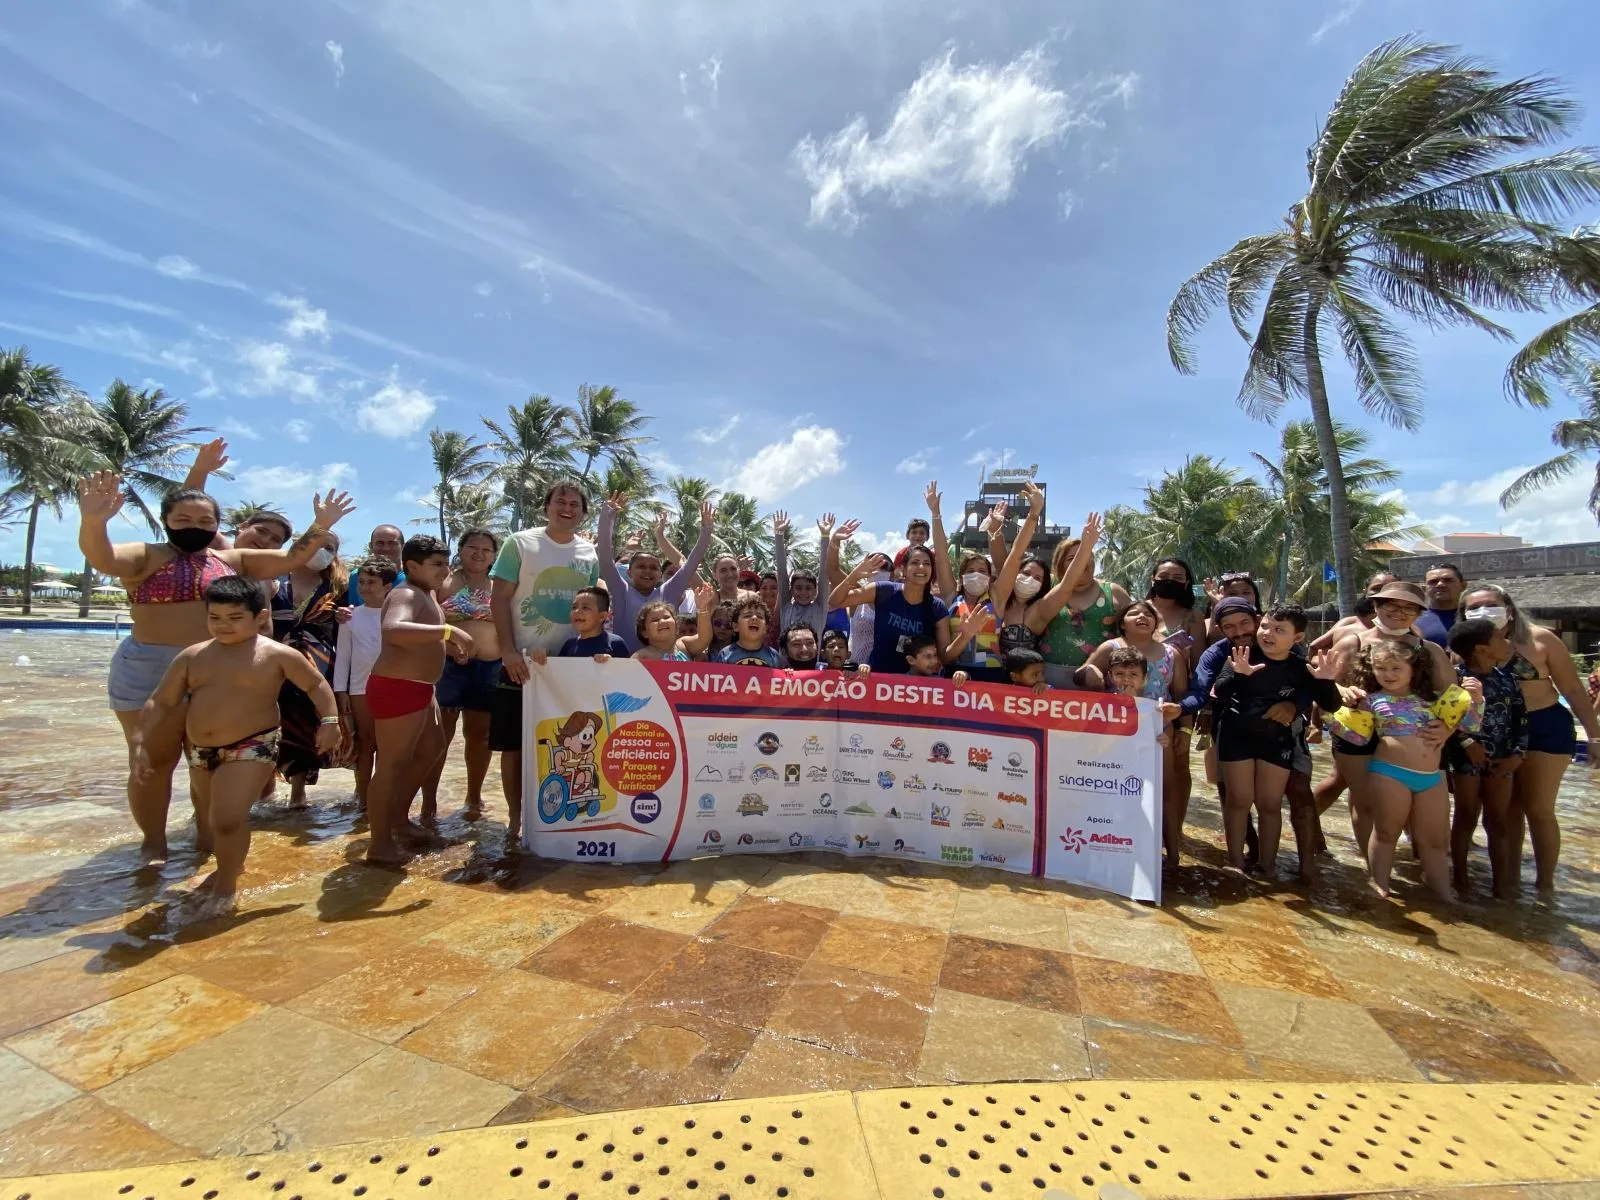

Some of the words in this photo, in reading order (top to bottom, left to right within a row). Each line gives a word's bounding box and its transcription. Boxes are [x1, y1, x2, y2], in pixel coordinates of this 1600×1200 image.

[887, 612, 923, 634] TREND
[667, 671, 738, 693] SINTA
[744, 676, 762, 695] A
[769, 675, 867, 702] EMOÇÃO
[875, 683, 945, 706] DESTE
[953, 690, 994, 712] DIA
[1003, 695, 1128, 724] ESPECIAL!
[636, 722, 649, 730] Dia
[707, 732, 738, 742] aldeia
[612, 738, 651, 748] pessoa
[607, 749, 670, 760] deficiência
[622, 761, 657, 772] Parques
[1077, 759, 1123, 770] Realização:
[623, 772, 662, 782] Atrações
[618, 780, 656, 791] Turísticas
[637, 803, 657, 811] sim!
[812, 808, 838, 816] OCEANIC
[1086, 815, 1113, 825] Apoio:
[1089, 833, 1133, 846] Adibra
[576, 841, 616, 857] 2021
